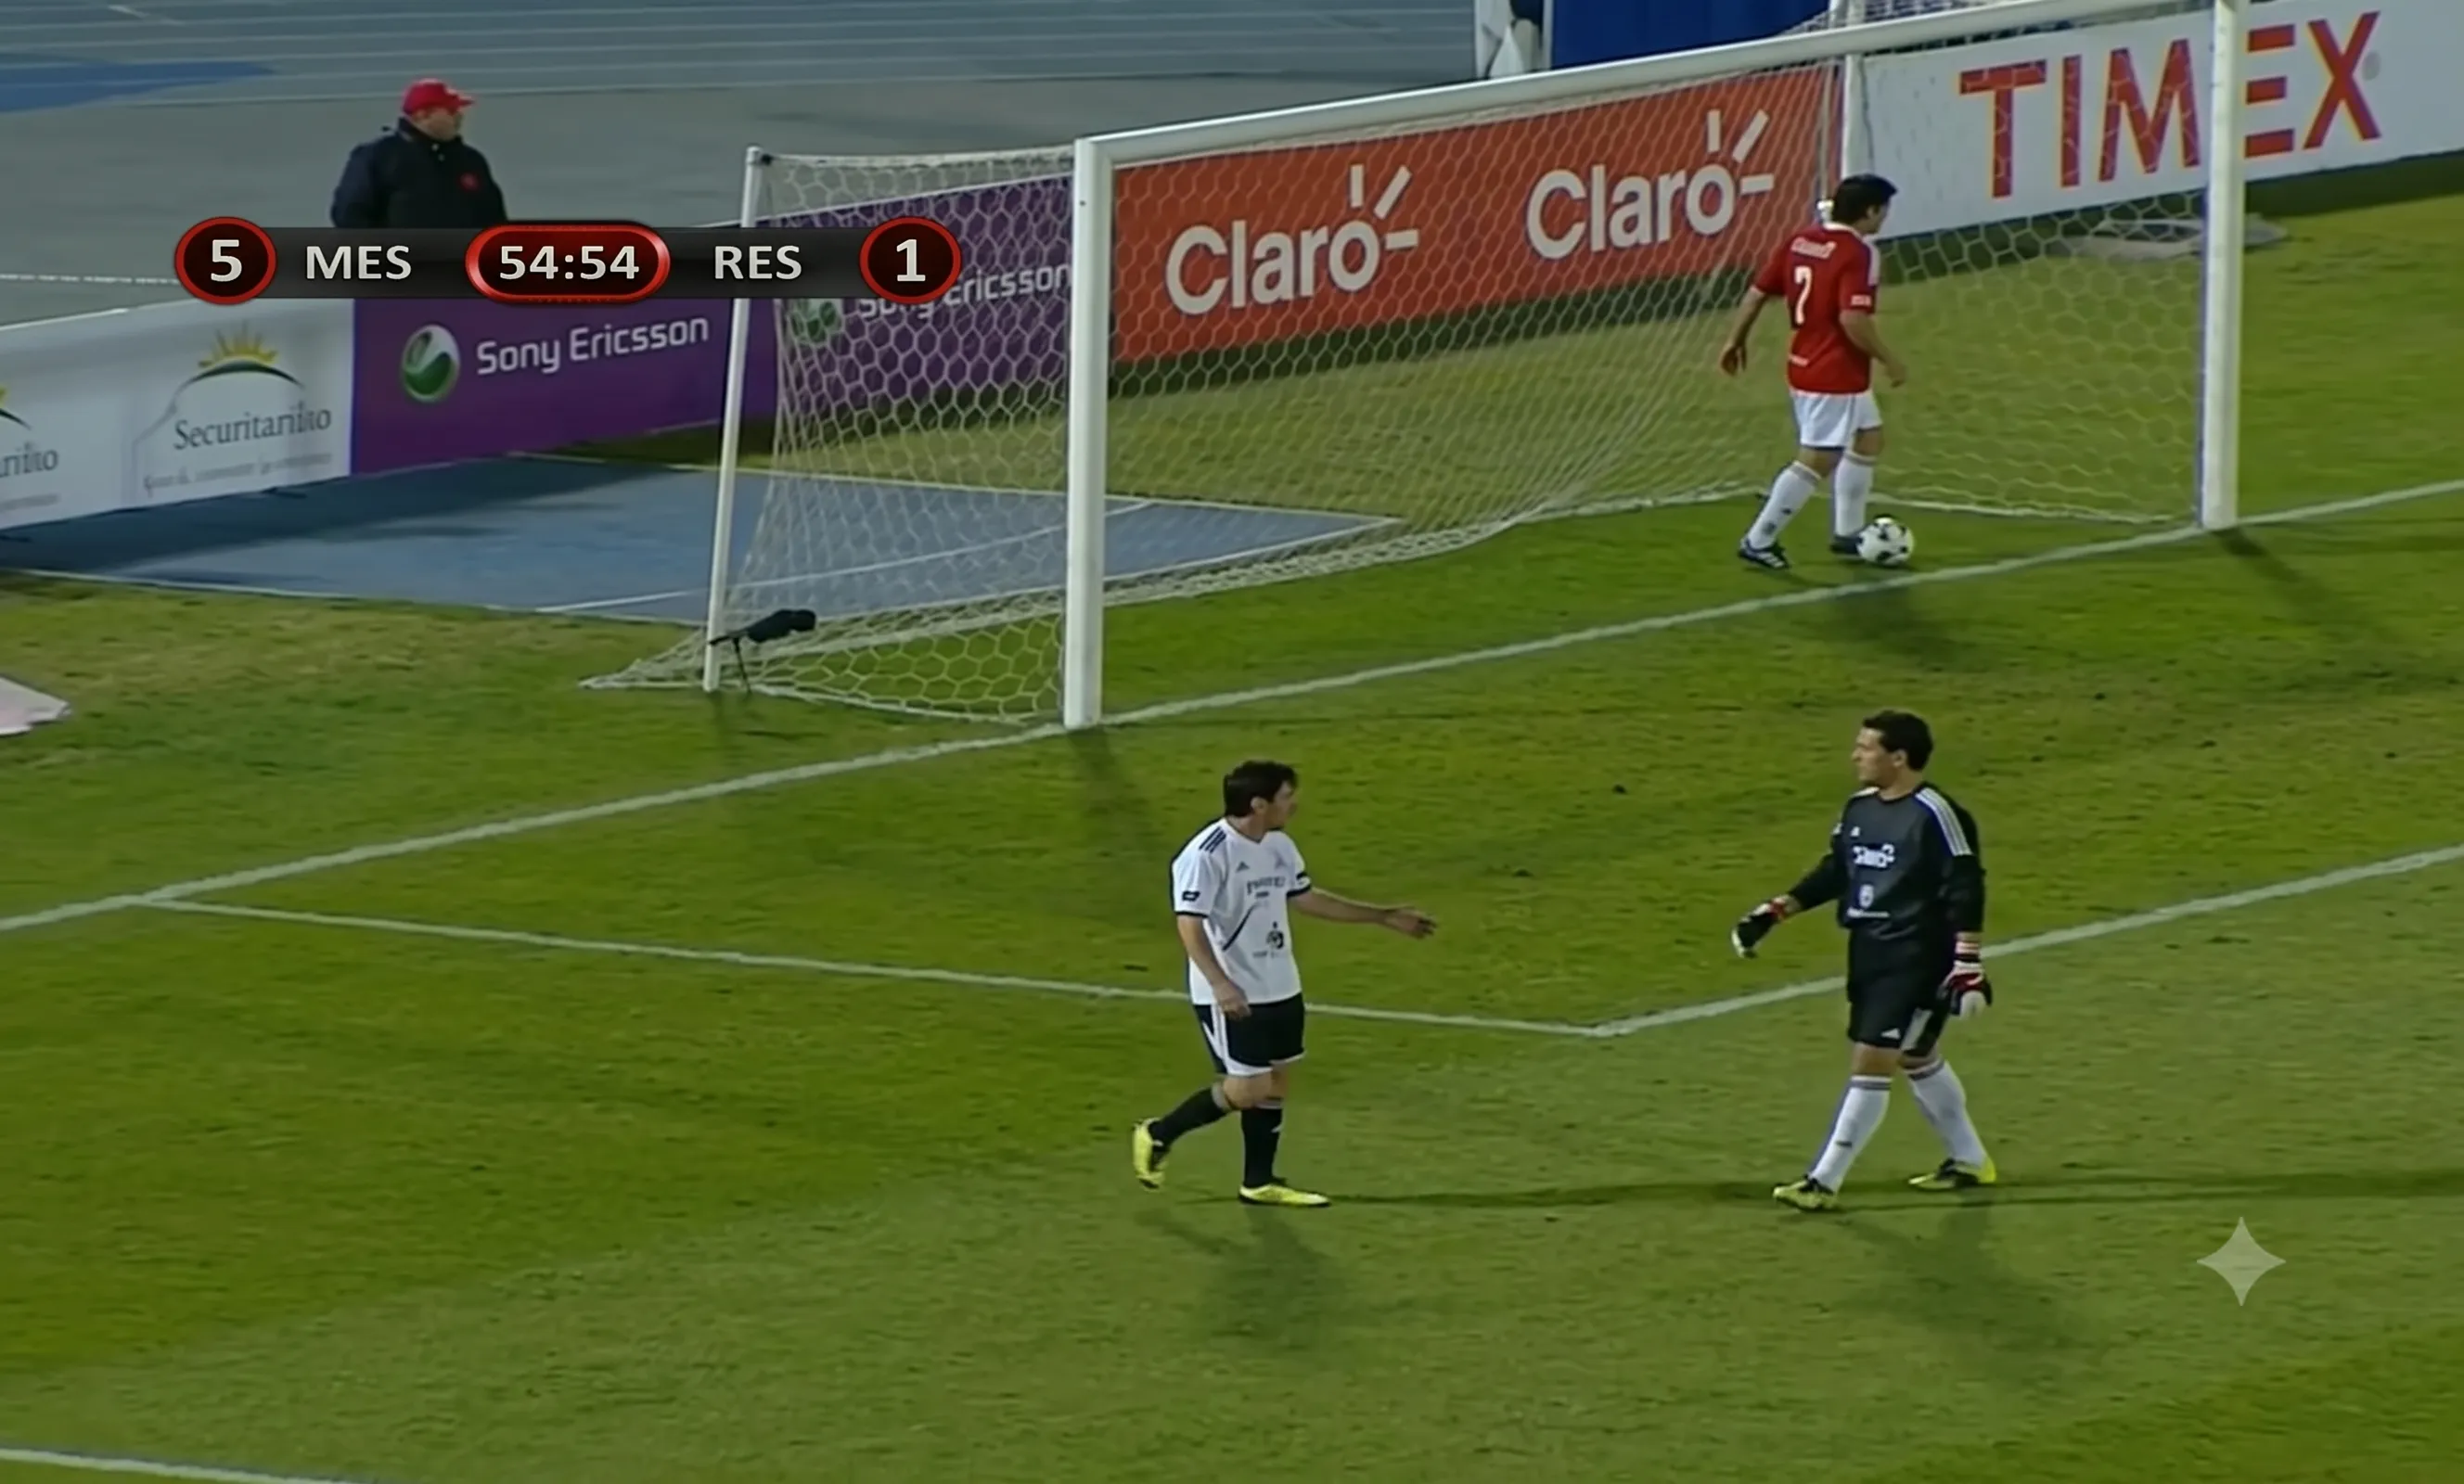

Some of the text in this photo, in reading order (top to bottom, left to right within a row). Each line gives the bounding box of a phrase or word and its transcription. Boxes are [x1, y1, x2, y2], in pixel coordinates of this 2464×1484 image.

[1958, 11, 2382, 199] TIMEX
[1527, 163, 1735, 260] Claro
[1165, 220, 1380, 314] Claro
[477, 316, 709, 375] Sony Ericsson
